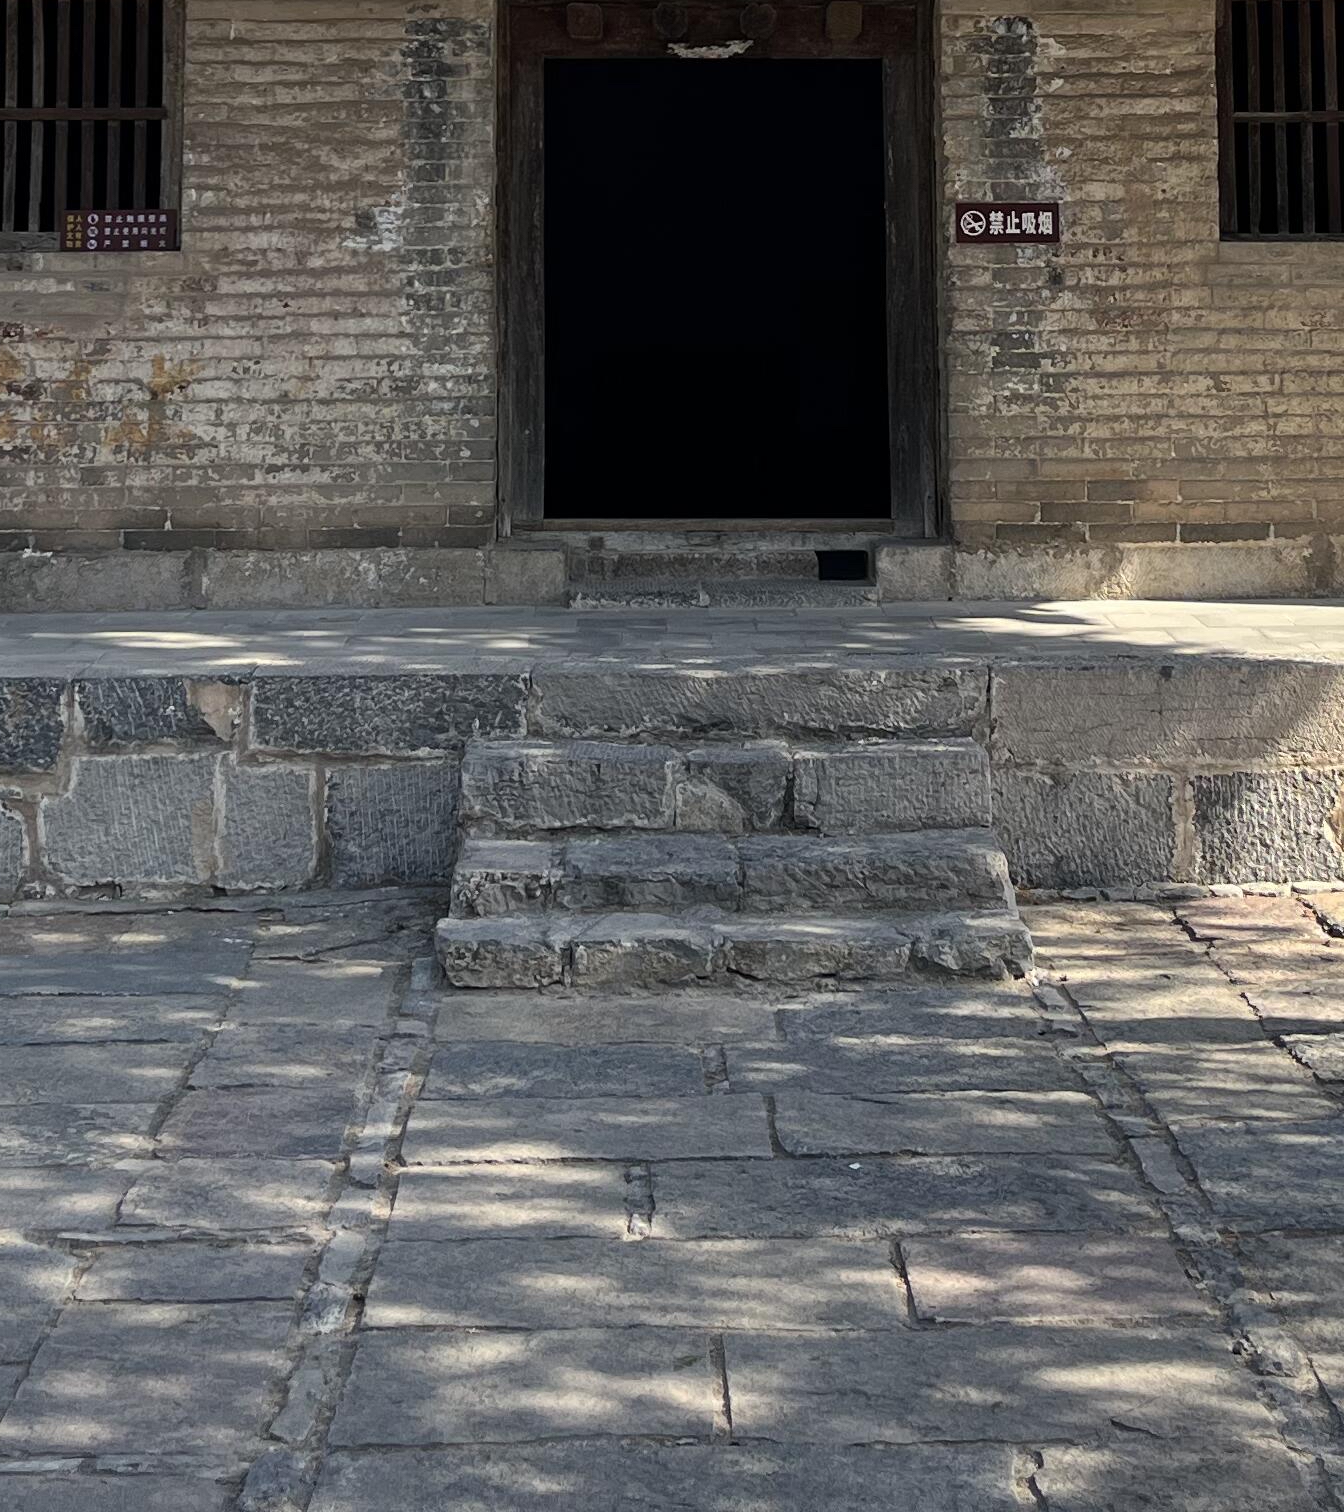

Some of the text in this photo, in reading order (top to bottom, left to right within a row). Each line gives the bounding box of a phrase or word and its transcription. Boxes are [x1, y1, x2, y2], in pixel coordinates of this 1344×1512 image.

[989, 210, 1053, 235] 禁止吸烟
[103, 240, 166, 248] 严禁烟火
